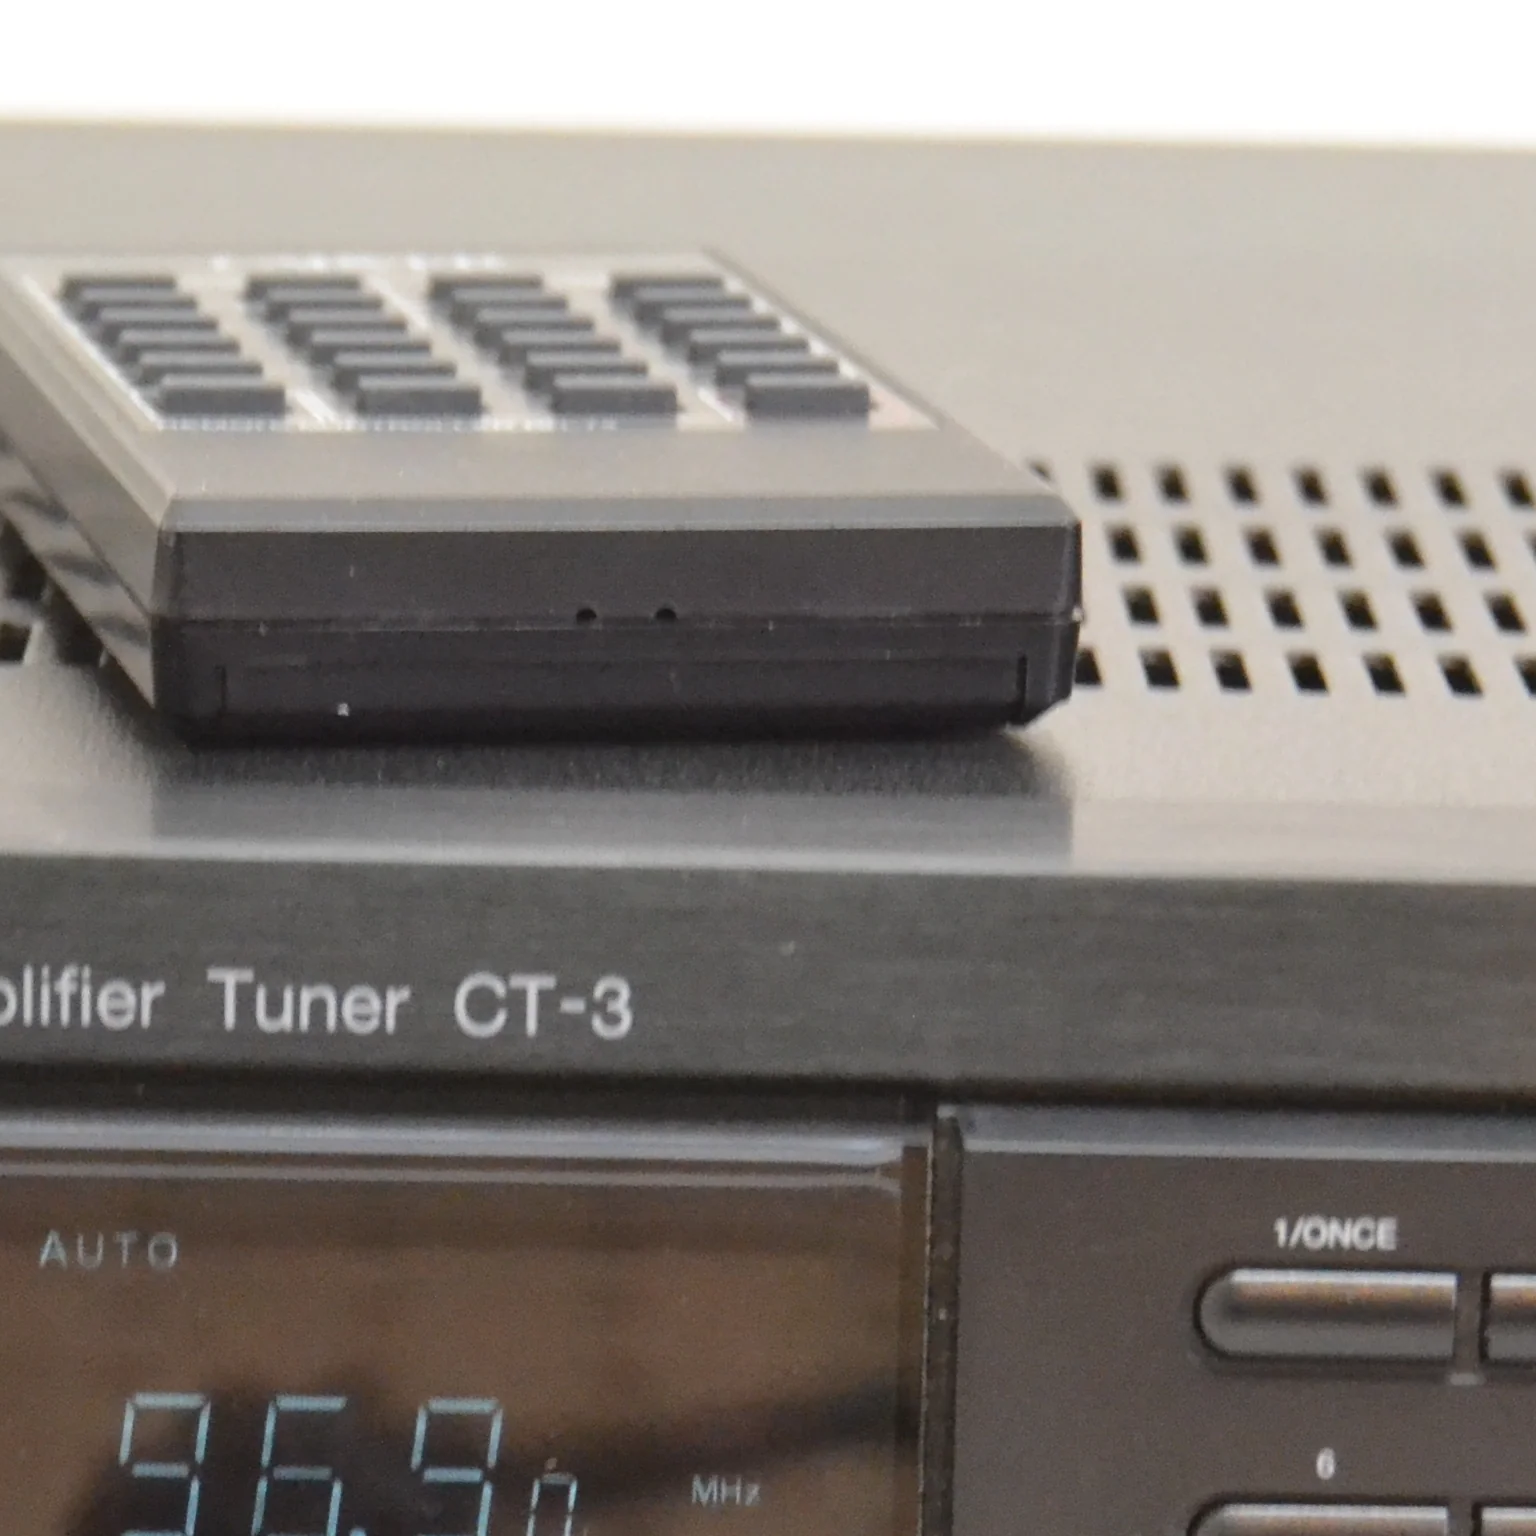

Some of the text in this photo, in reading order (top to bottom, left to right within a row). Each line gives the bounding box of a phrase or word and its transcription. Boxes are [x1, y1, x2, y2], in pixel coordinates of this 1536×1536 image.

[207, 967, 411, 1036] Tuner
[453, 974, 634, 1040] CT-3
[39, 1232, 180, 1271] AUTO
[1273, 1216, 1398, 1252] 1/ONCE
[1316, 1449, 1335, 1481] 6
[691, 1474, 761, 1508] MHz
